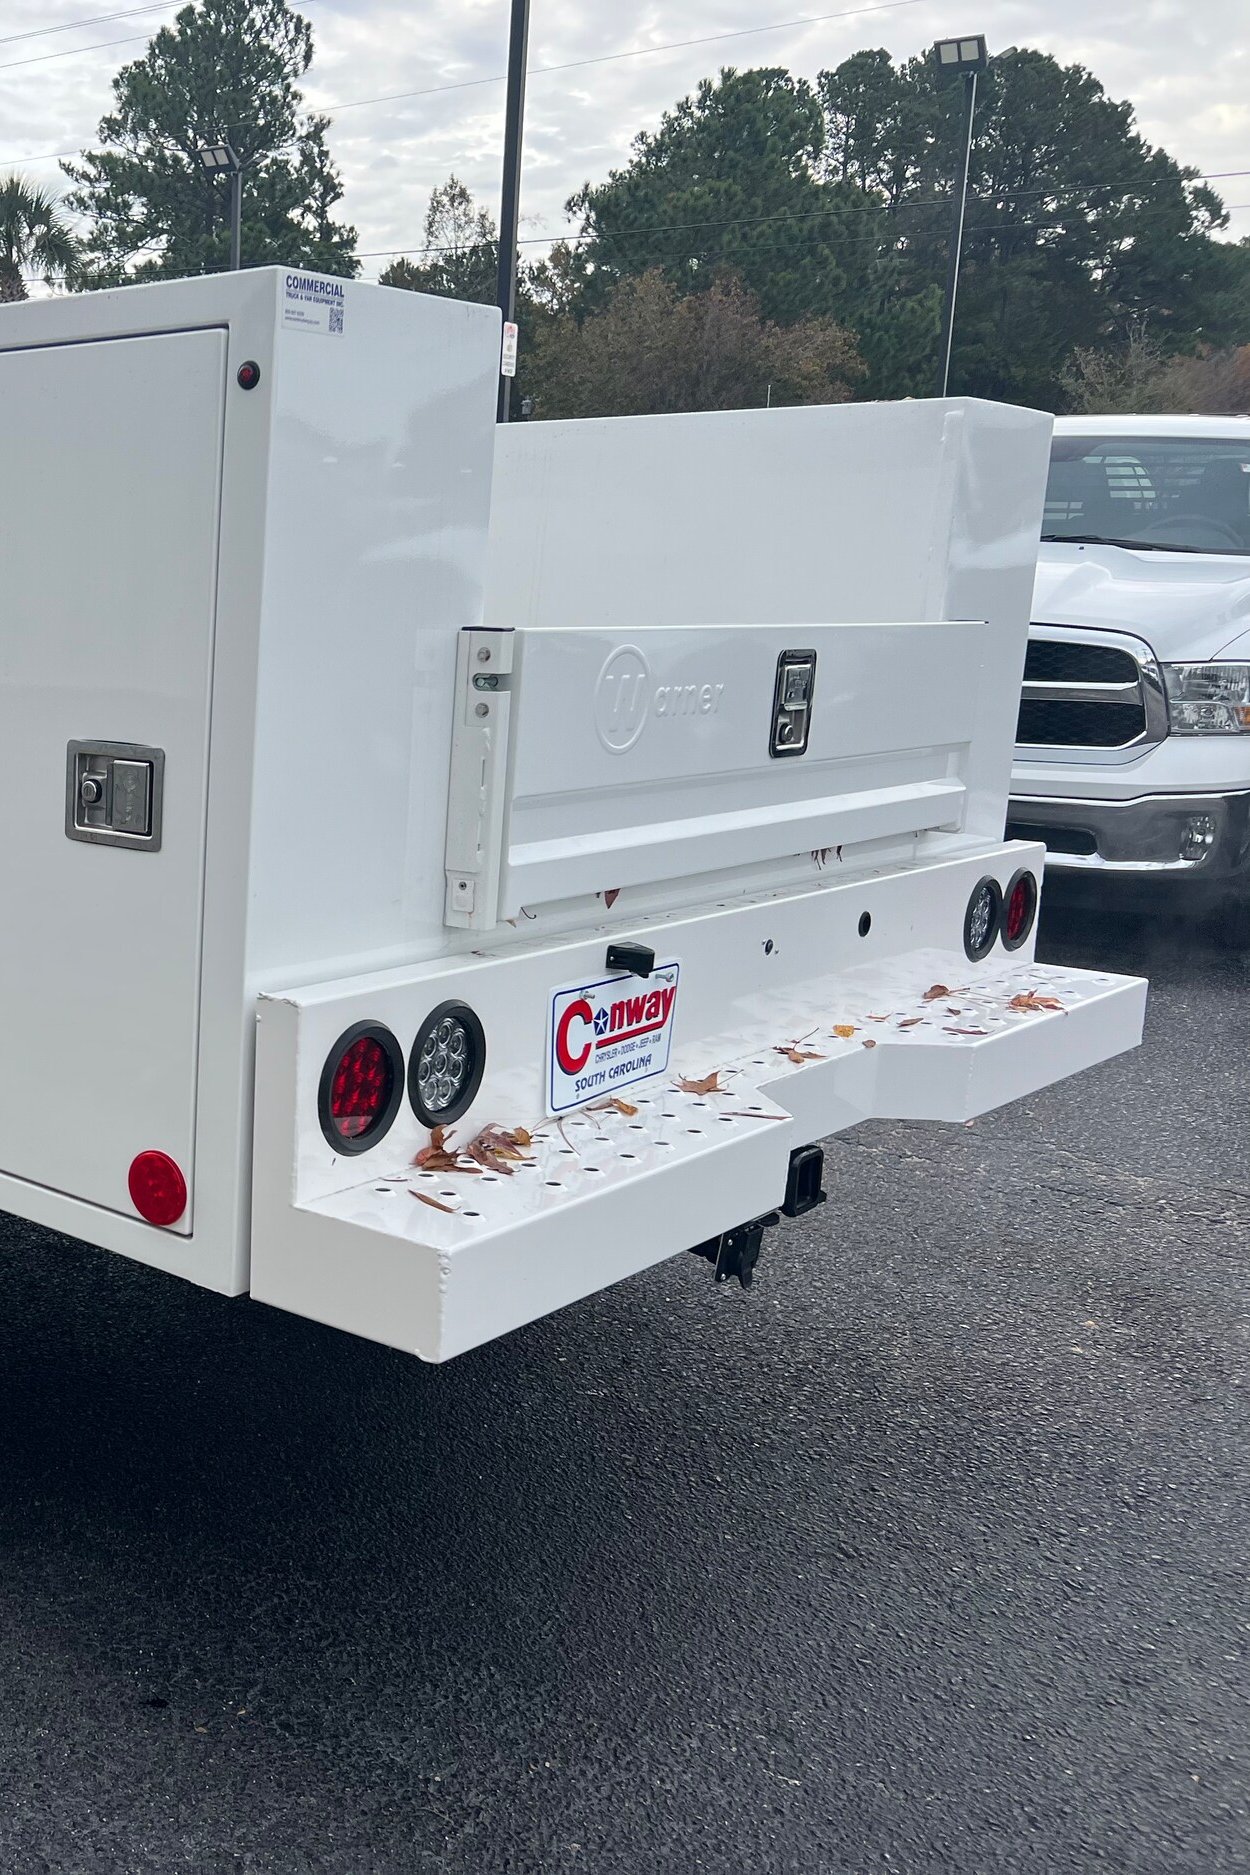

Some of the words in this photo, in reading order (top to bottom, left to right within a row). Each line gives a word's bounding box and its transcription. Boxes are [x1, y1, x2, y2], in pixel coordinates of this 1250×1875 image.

[286, 275, 345, 298] COMMERCIAL
[595, 1047, 618, 1064] CHRYSLER
[620, 1041, 636, 1056] DODGE
[575, 1070, 606, 1092] SOUTH
[608, 1053, 653, 1079] CAROLINA
